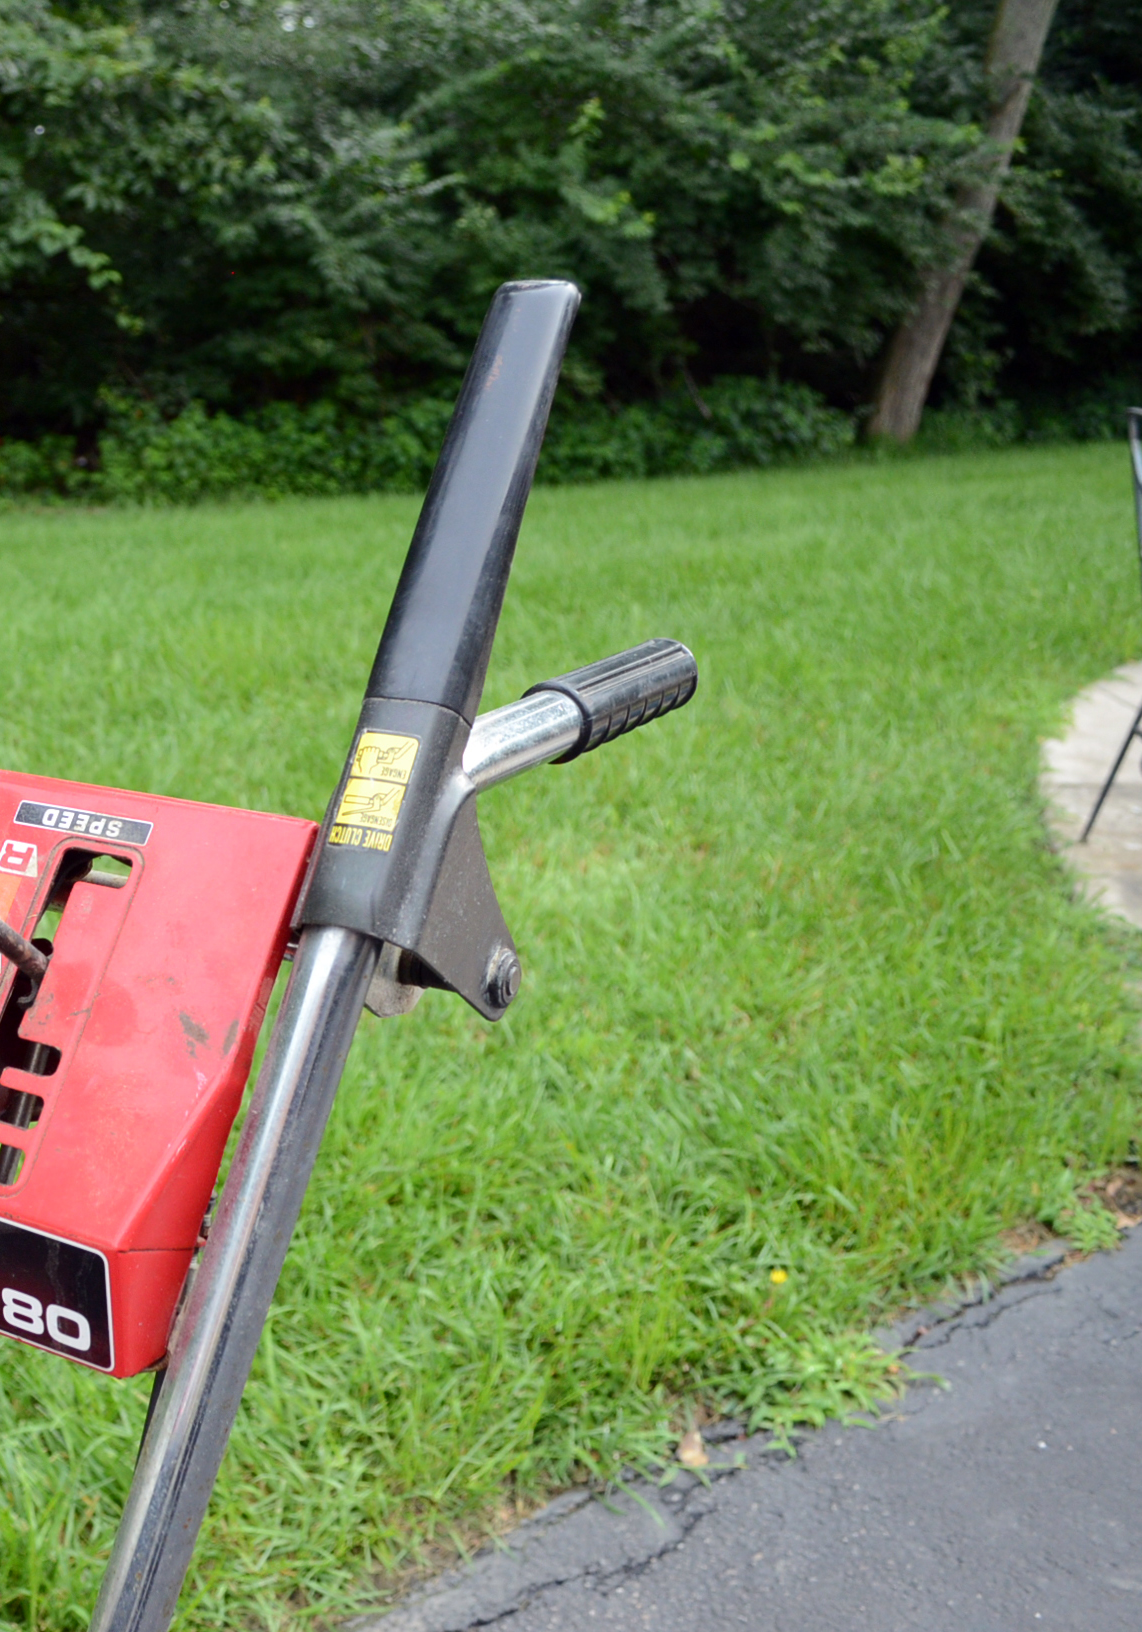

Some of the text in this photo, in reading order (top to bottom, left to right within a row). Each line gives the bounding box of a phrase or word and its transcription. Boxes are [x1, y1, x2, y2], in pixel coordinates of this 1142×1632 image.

[380, 766, 407, 779] ENGAGE
[42, 808, 123, 837] SPEED
[360, 812, 393, 828] DISENGAGE
[328, 825, 394, 852] DRIVE CLUTCH
[0, 842, 34, 873] R
